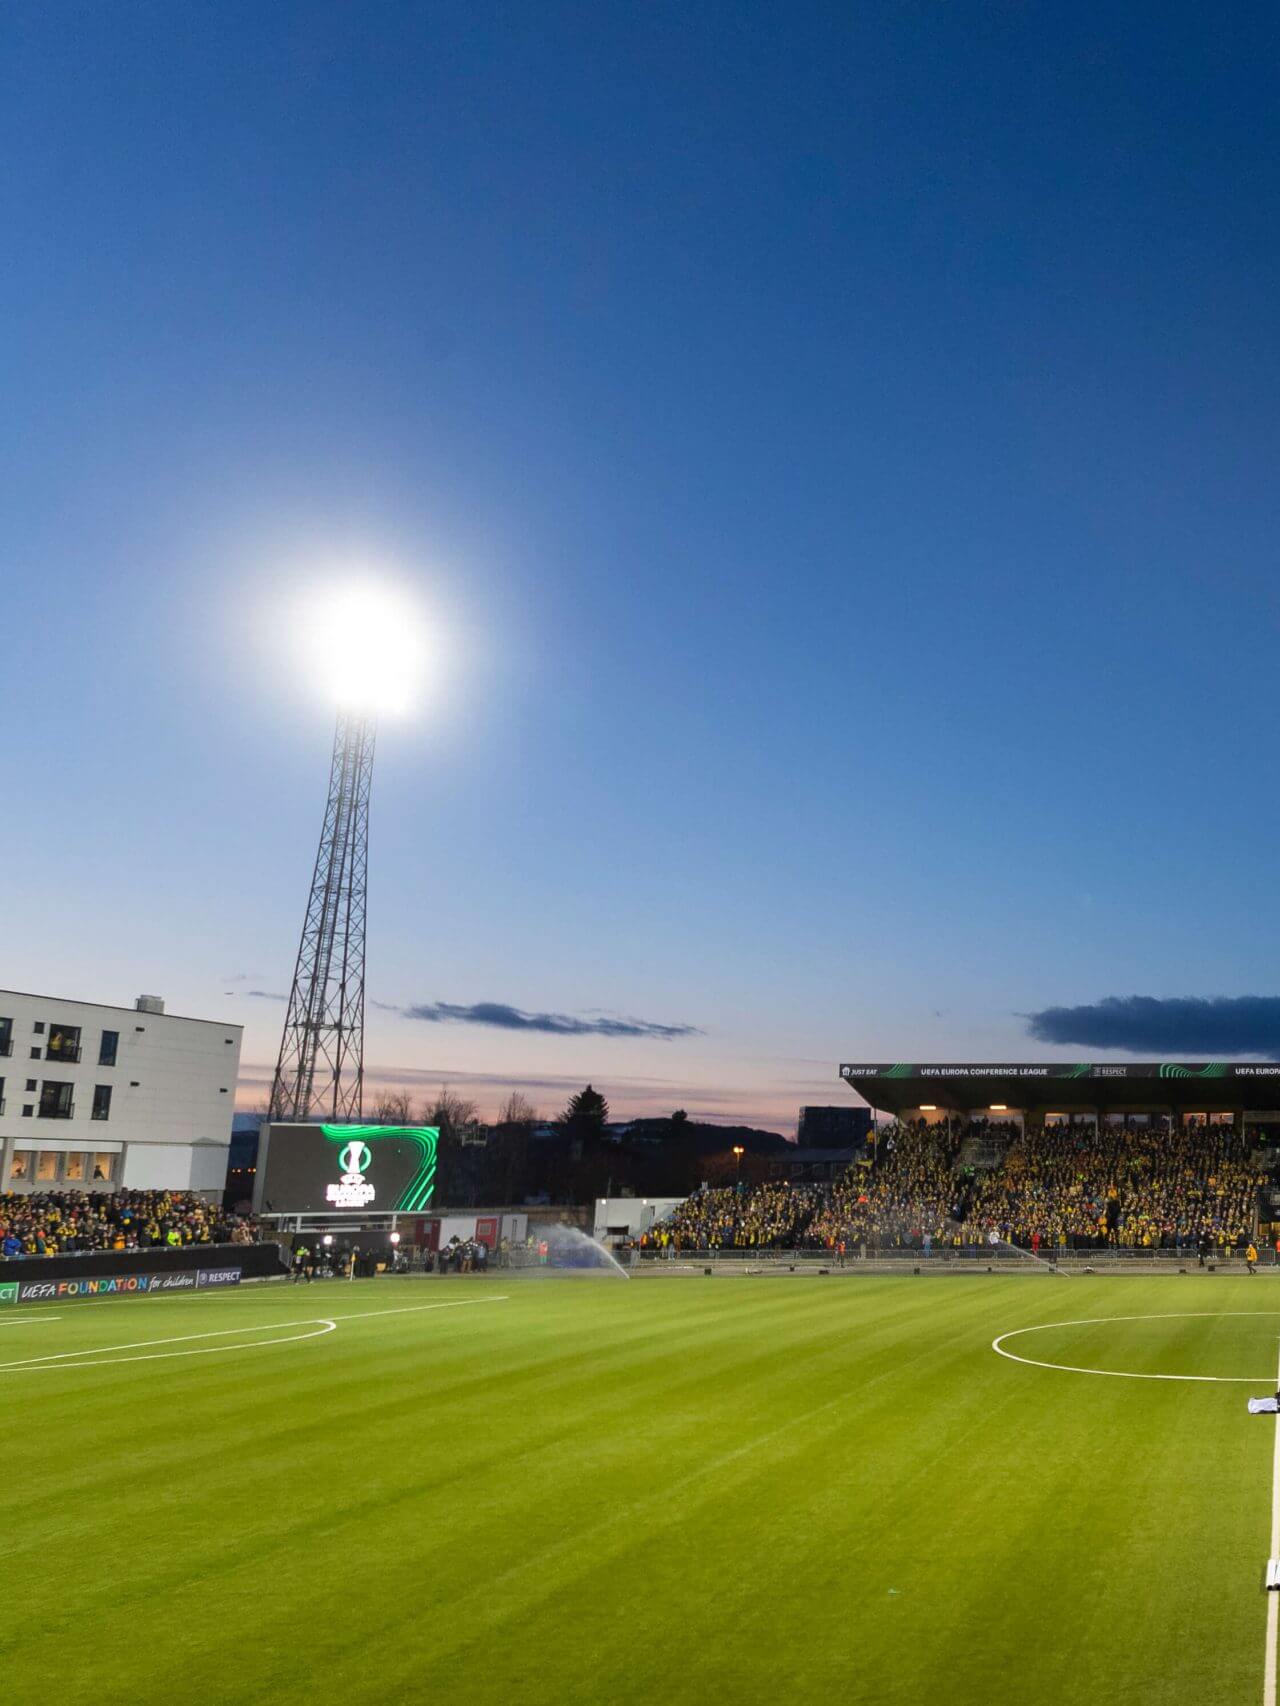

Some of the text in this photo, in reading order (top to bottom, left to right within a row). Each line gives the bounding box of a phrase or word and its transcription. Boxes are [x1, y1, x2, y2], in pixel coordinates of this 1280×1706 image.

[921, 1068, 1048, 1076] UEFA EUROPA CONFERENCE LEAGUE
[1235, 1067, 1255, 1075] UEFA
[208, 1271, 240, 1283] RESPECT
[21, 1284, 56, 1298] UEFA
[148, 1276, 161, 1292] for
[162, 1275, 194, 1288] children
